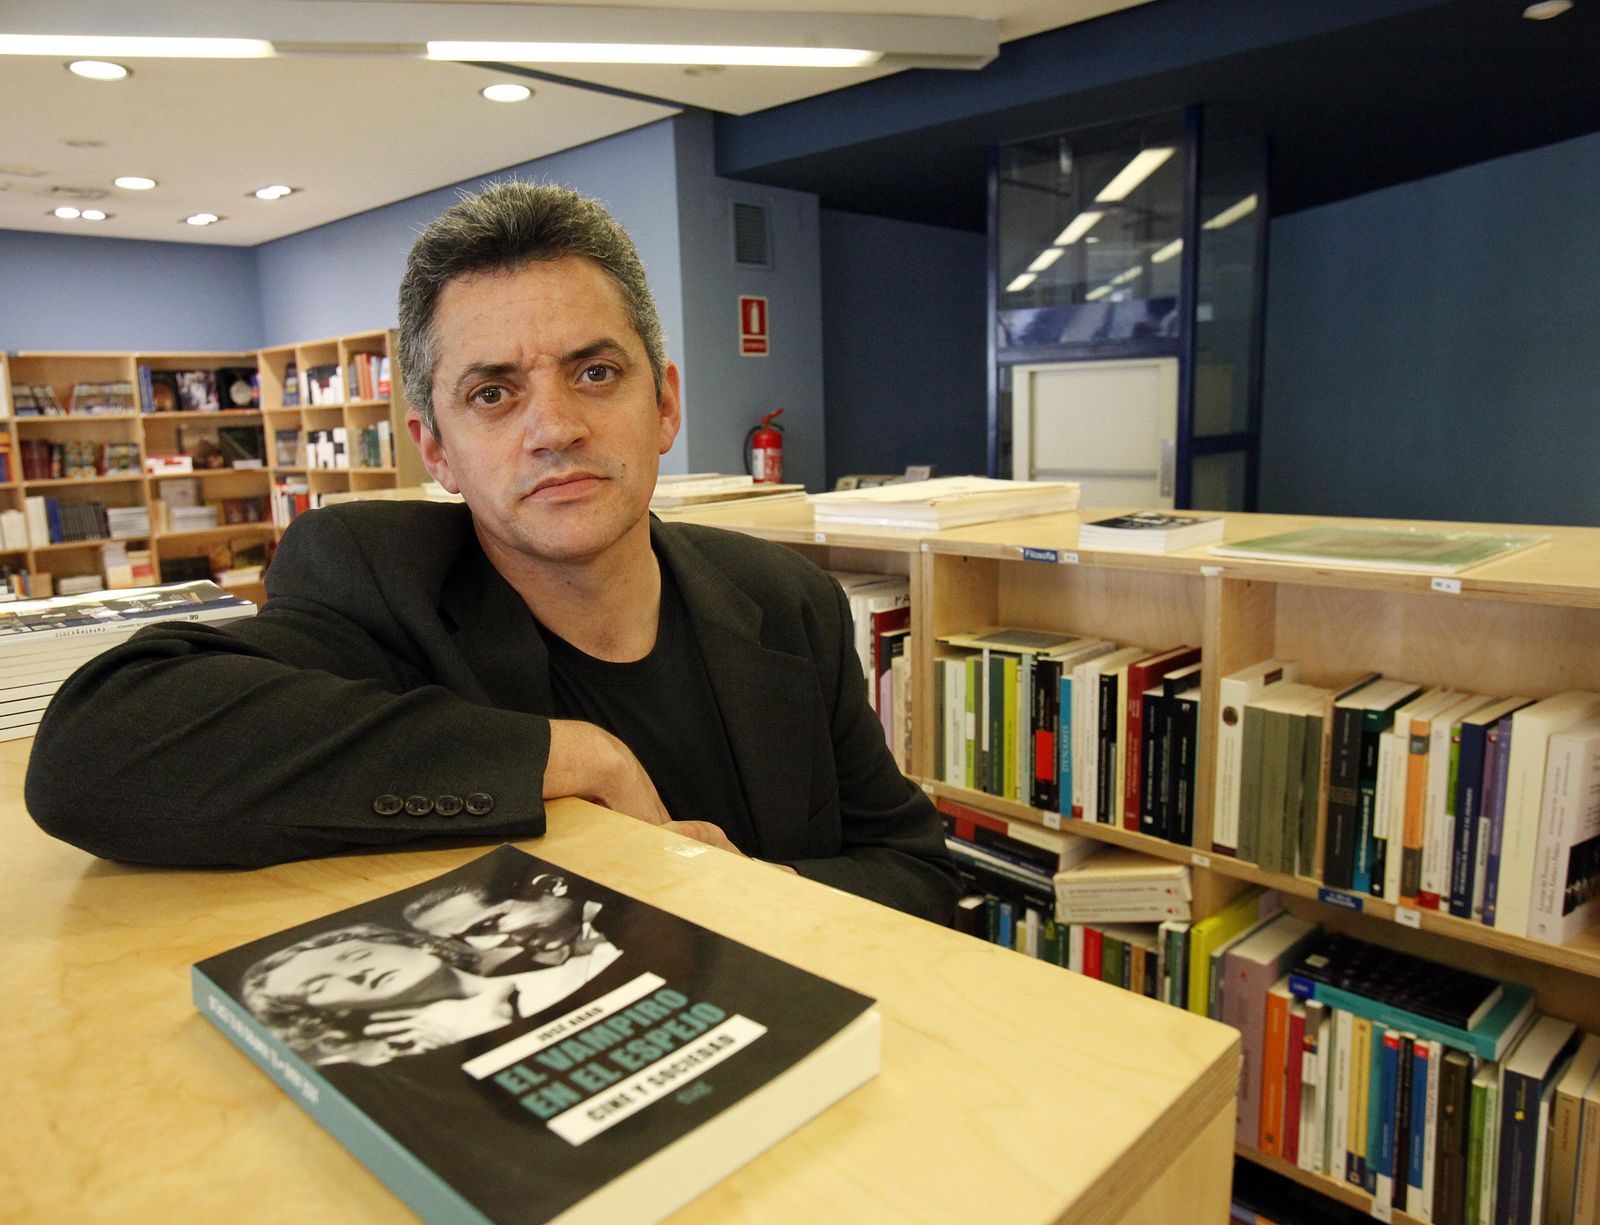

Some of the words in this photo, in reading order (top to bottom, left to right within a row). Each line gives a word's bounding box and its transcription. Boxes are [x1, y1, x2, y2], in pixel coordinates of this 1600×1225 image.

[493, 1063, 548, 1096] EL
[534, 988, 689, 1072] VAMPIRO
[519, 1080, 583, 1121] EN
[568, 1062, 624, 1094] EL
[608, 1002, 726, 1071] ESPEJO
[585, 1093, 633, 1123] CINE
[635, 1083, 651, 1099] Y
[647, 1032, 737, 1090] SOCIEDAD
